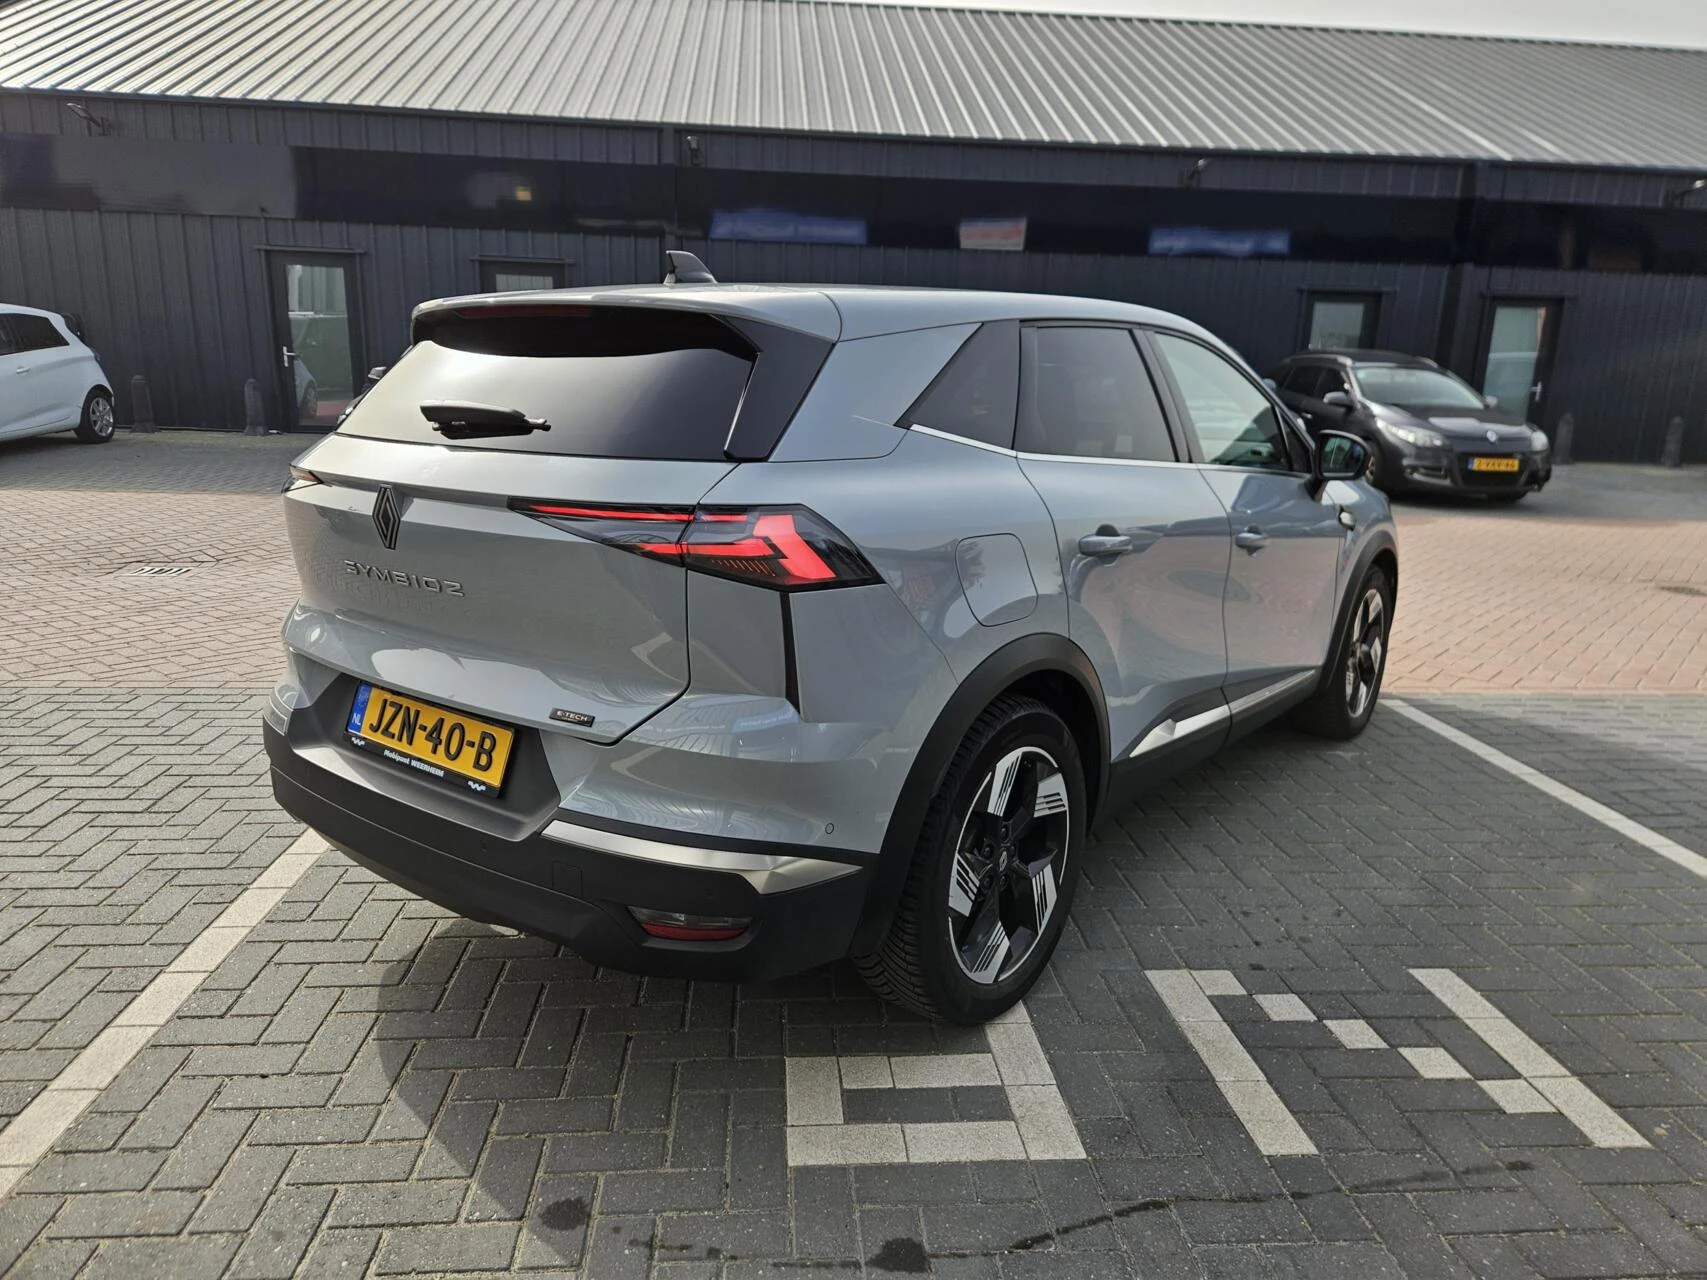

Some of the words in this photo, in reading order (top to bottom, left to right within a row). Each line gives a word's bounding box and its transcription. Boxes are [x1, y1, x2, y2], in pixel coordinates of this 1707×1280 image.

[344, 560, 465, 597] SYMBIOZ
[352, 713, 361, 725] NL
[369, 699, 497, 772] JZN-40-B
